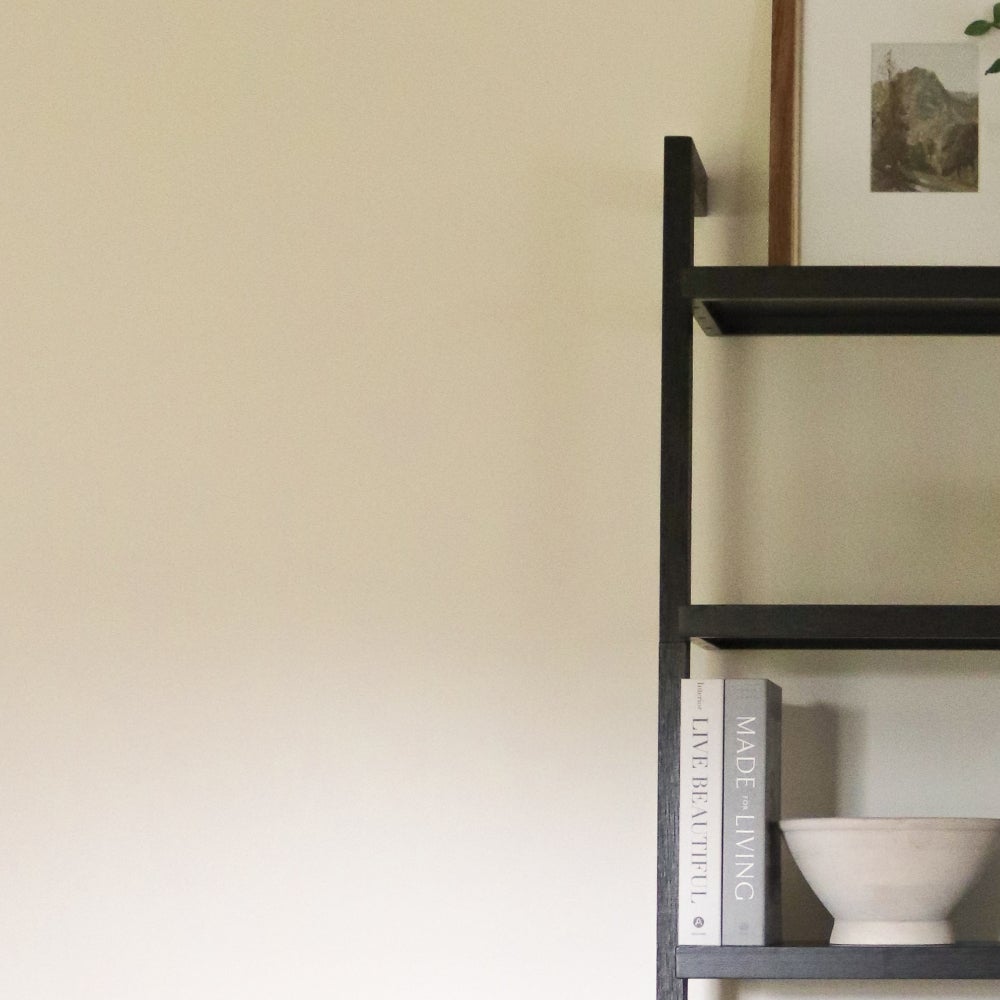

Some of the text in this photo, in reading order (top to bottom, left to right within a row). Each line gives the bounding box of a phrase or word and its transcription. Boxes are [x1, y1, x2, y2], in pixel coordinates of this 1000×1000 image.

[736, 716, 756, 789] MADE
[691, 718, 708, 904] LIVE BEAUTIFUL
[741, 795, 749, 812] FOR
[735, 815, 755, 900] LIVING
